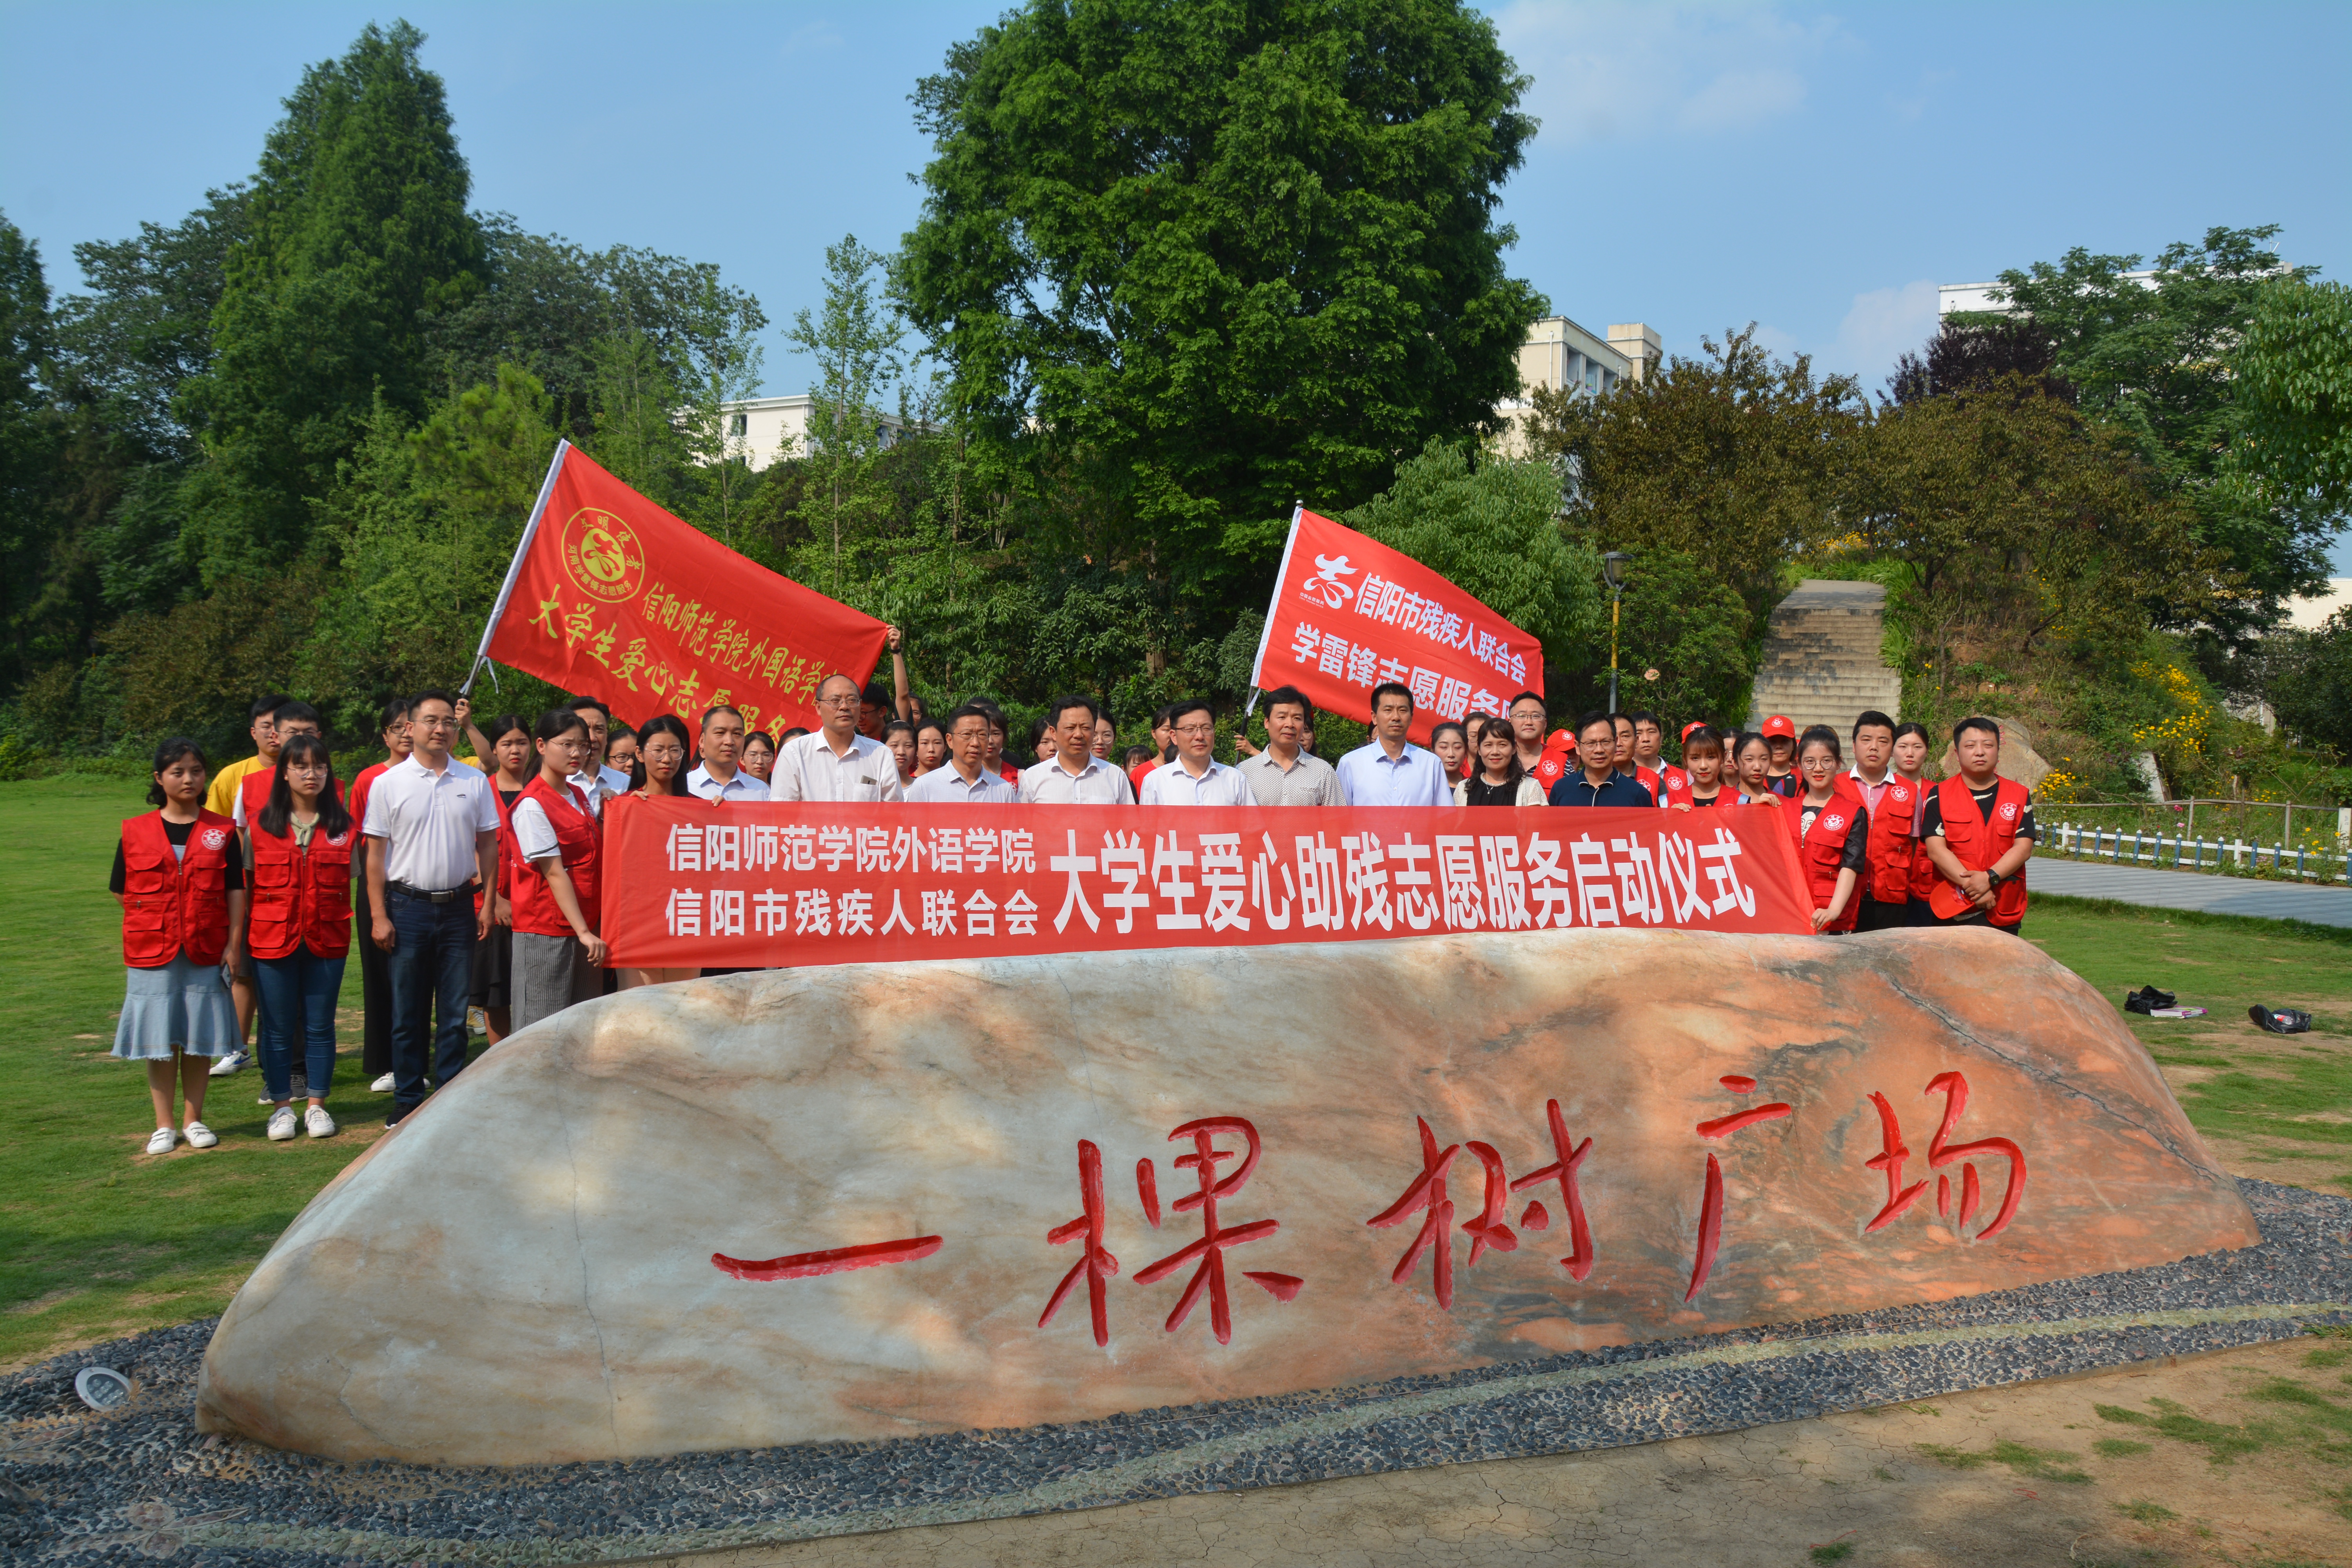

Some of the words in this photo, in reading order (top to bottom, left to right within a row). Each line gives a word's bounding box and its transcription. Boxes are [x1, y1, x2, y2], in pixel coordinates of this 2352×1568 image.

[580, 515, 642, 570] 文明使者
[642, 581, 837, 706] 信阳师范学院外国语学
[1291, 621, 1511, 723] 学雷锋志愿服务
[1354, 572, 1526, 686] 信阳市残疾人联合会
[666, 823, 1036, 873] 信阳师范学院外语学院
[1050, 828, 1756, 935] 大学生爱心助残志愿服务启动仪式
[666, 888, 1038, 936] 信阳市残疾人联合会
[712, 1070, 2027, 1348] 一棵树广场
